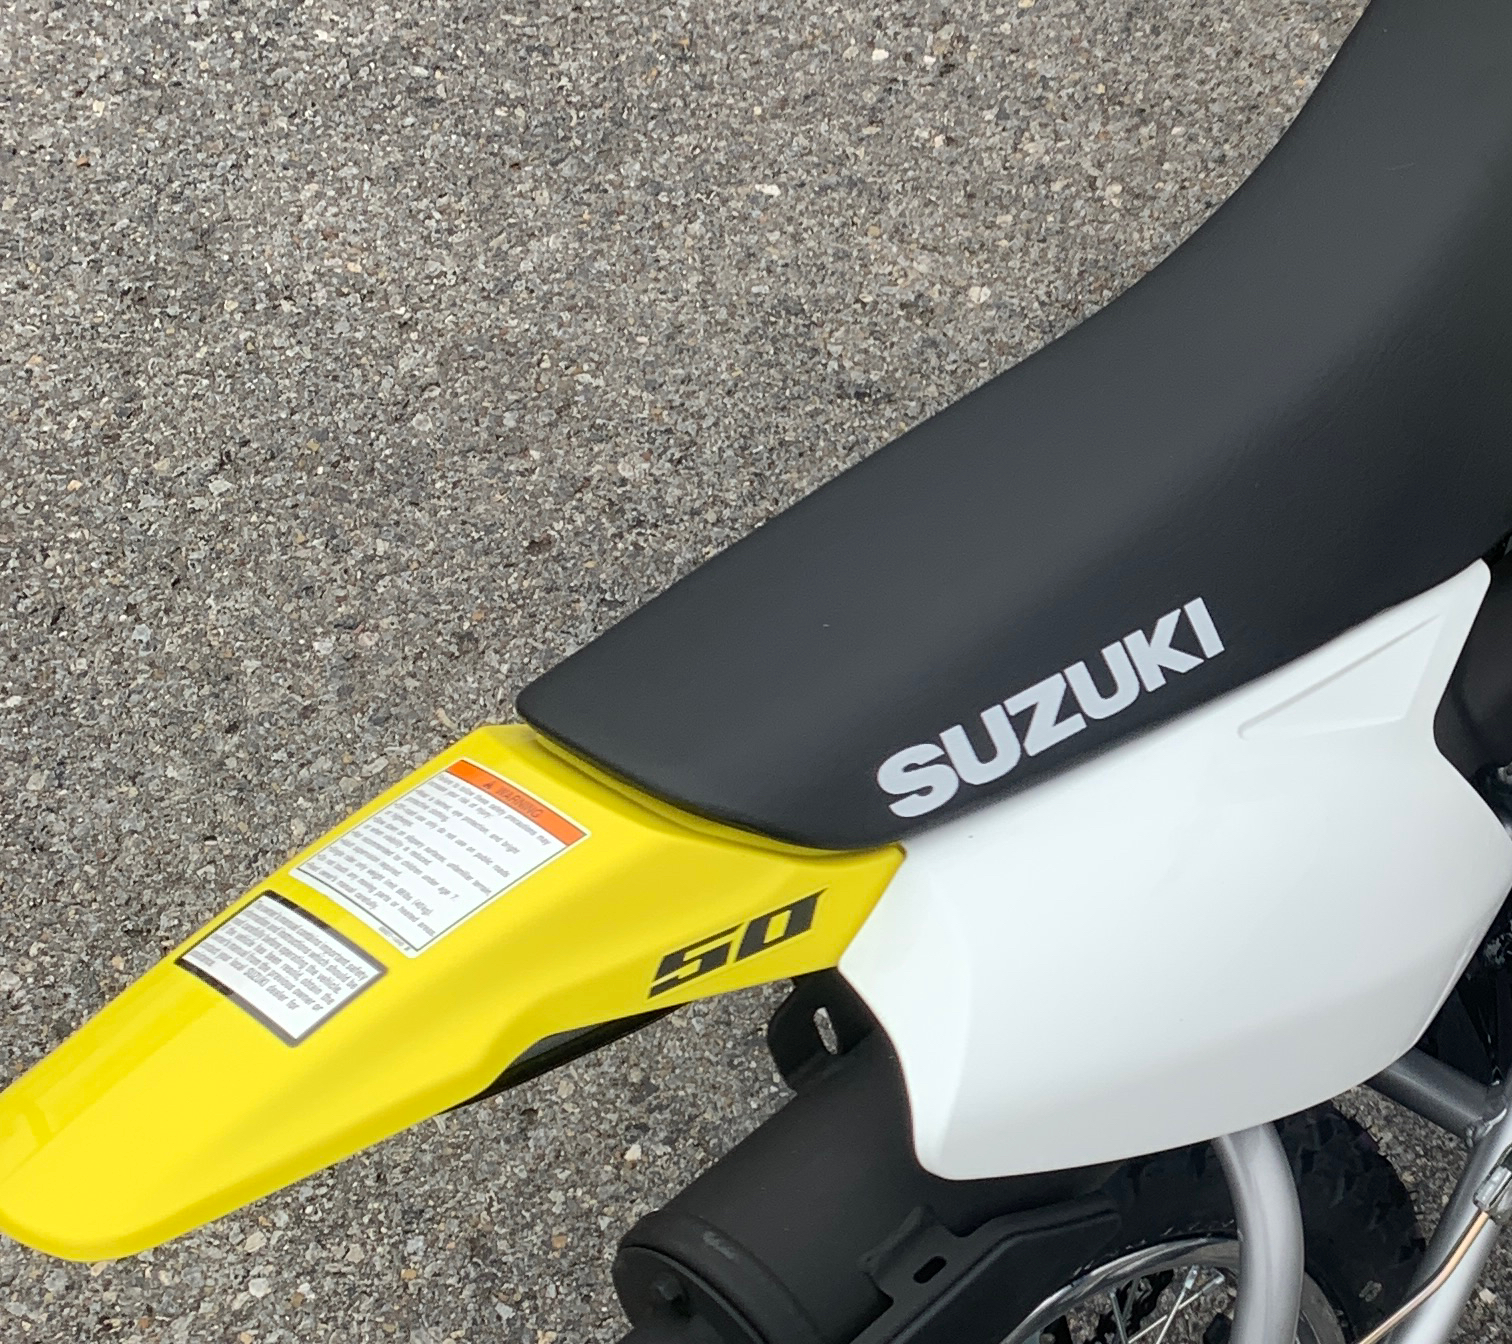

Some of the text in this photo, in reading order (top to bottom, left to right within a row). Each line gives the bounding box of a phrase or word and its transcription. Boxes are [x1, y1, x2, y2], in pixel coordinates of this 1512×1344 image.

[876, 597, 1225, 818] SUZUKI
[493, 787, 544, 818] WARNING
[647, 887, 829, 999] 50
